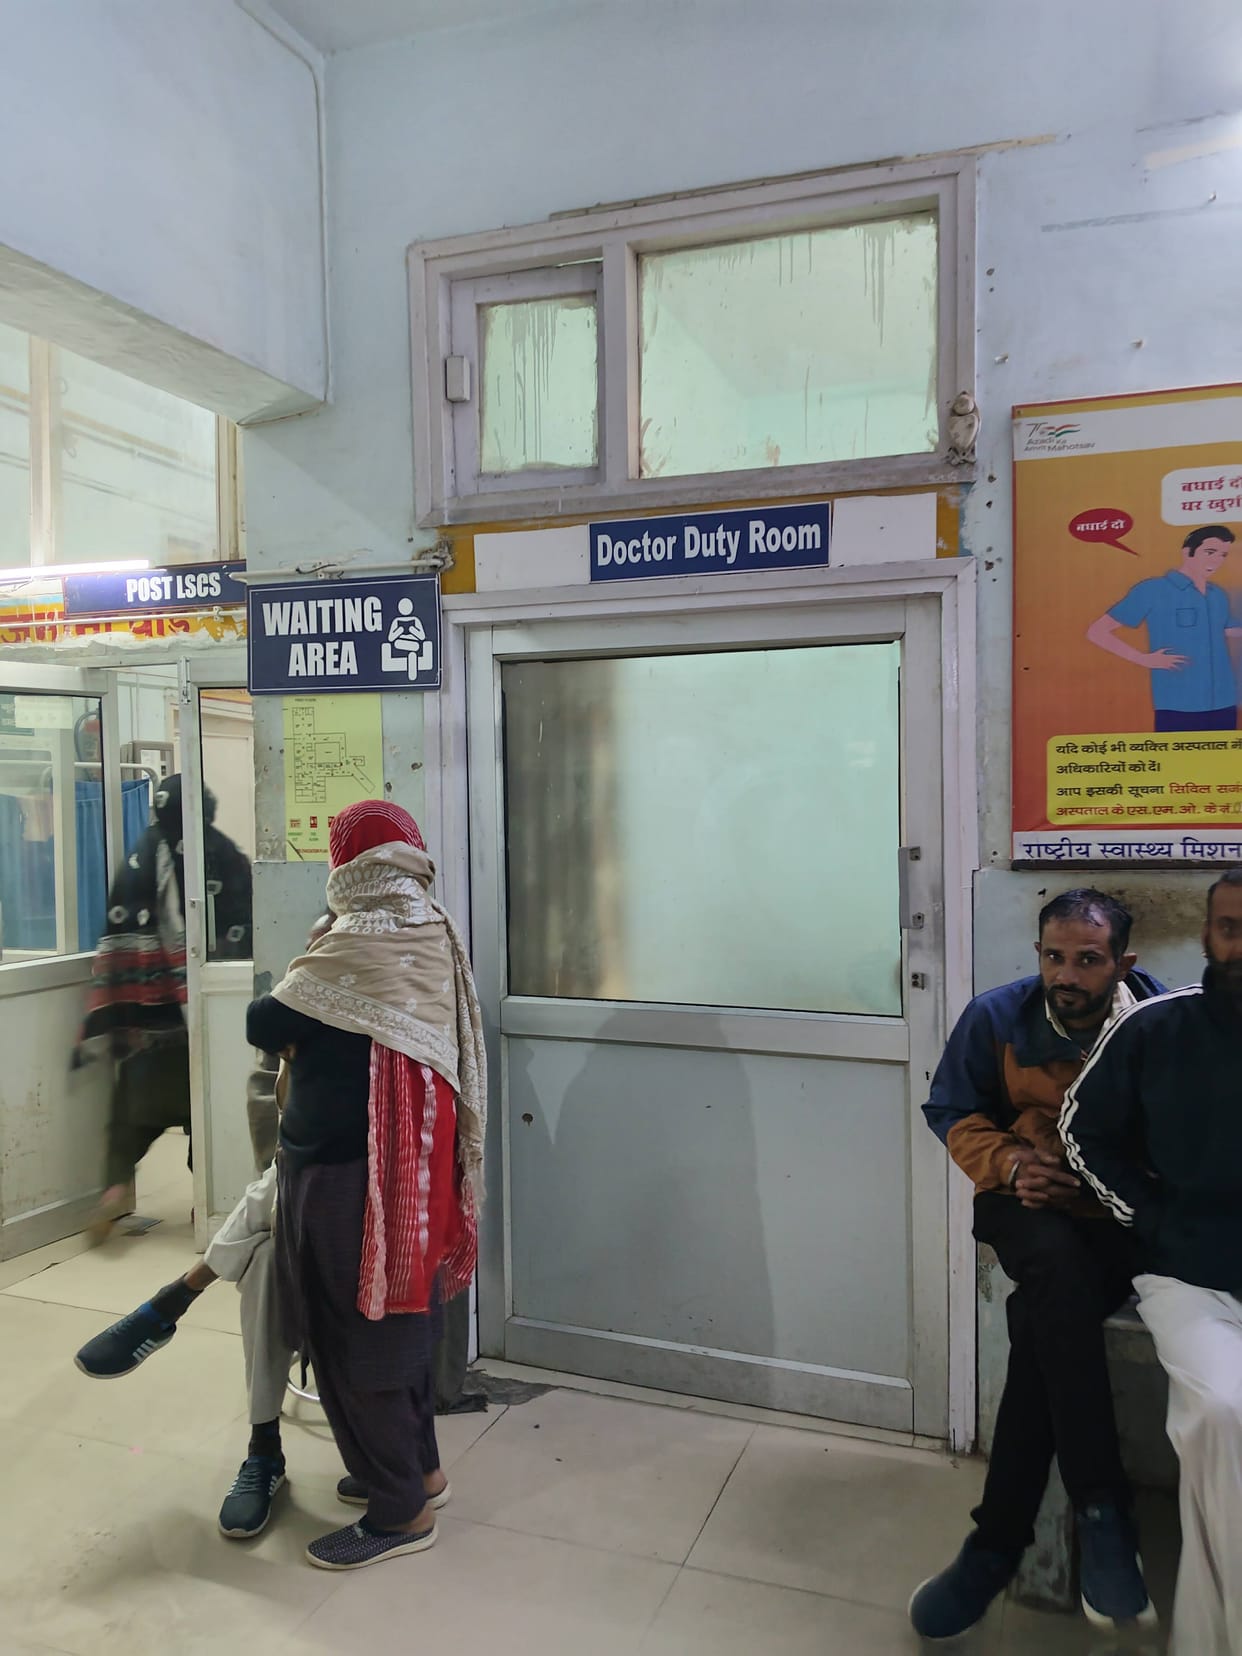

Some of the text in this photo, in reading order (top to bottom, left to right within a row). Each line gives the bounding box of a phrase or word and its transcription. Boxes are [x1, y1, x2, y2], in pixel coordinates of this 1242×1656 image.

[597, 520, 821, 566] Doctor Duty Room
[126, 572, 222, 603] POST LSCS
[262, 596, 383, 636] WAITING
[288, 641, 359, 677] AREA
[1056, 742, 1079, 754] यदि
[1081, 741, 1108, 756] कोई
[1110, 741, 1126, 753] भी
[1172, 741, 1228, 752] अस्पताल
[1056, 761, 1126, 775] अधिकारियों
[1128, 760, 1146, 773] को
[1056, 787, 1081, 798] आप
[1086, 784, 1123, 798] इसकी
[1128, 785, 1164, 798] सूचना
[1169, 782, 1211, 795] सिविल
[1056, 806, 1109, 817] अस्पताल
[1111, 803, 1125, 816] के
[1022, 836, 1242, 860] राष्ट्रीय स्वास्थ्य मिशन
